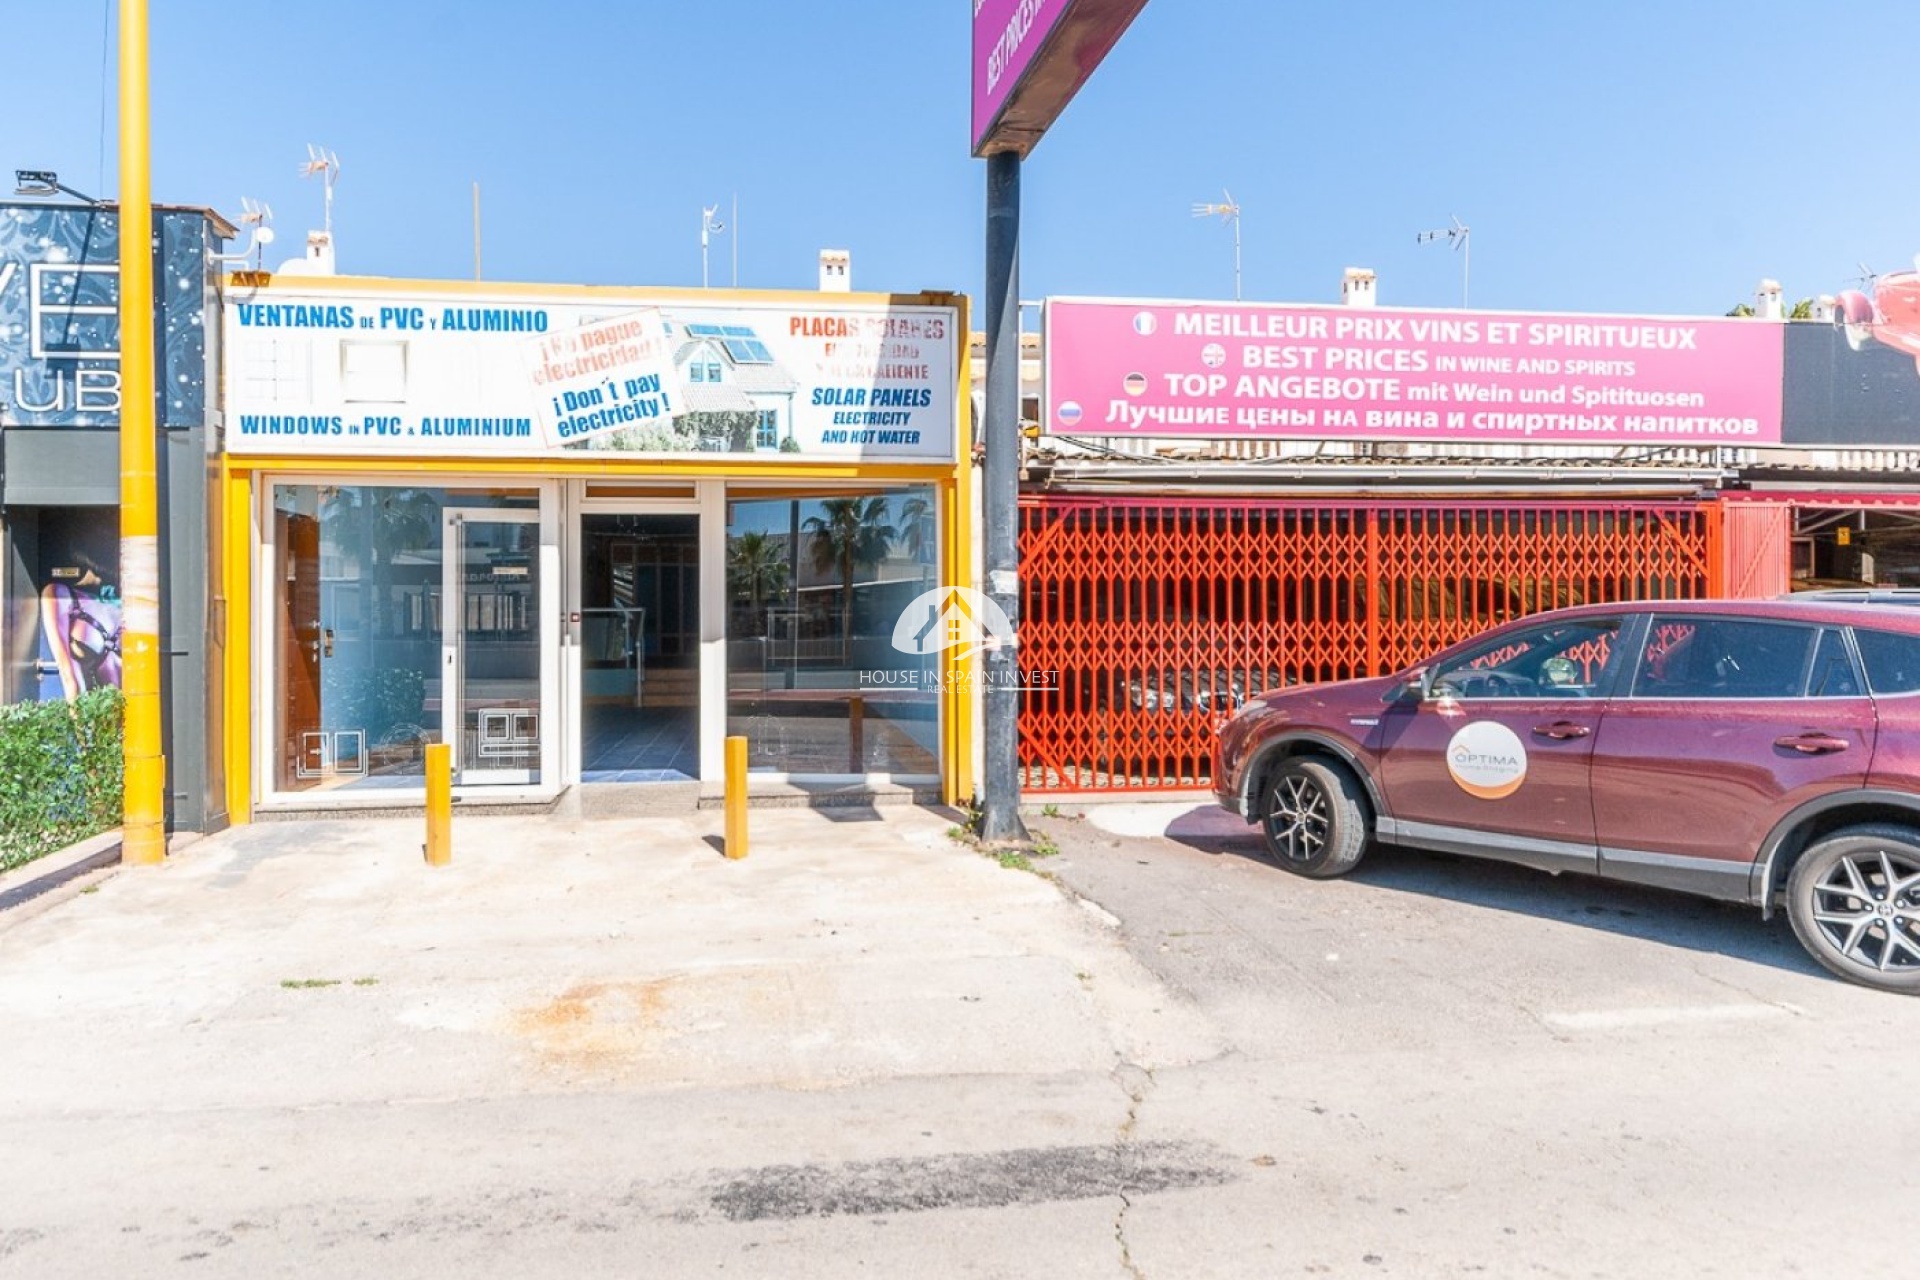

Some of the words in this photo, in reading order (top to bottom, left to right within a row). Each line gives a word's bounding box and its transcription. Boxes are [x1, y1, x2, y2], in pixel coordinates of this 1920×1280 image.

[987, 32, 1006, 96] BEST
[238, 303, 354, 328] VENTANAS
[359, 316, 374, 328] DE
[380, 307, 424, 330] PVC
[429, 318, 437, 331] Y
[442, 309, 548, 332] ALUMINIO
[789, 316, 860, 338] PLACAS
[865, 317, 945, 340] OLARES
[1174, 312, 1328, 340] MEILLEUR
[1335, 316, 1403, 341] PRIX
[1411, 319, 1480, 344] VINS
[1487, 322, 1522, 345] ET
[1528, 322, 1697, 350] SPIRITUEUX
[580, 320, 643, 351] pague
[1243, 344, 1318, 369] BEST
[1325, 347, 1429, 372] PRICES
[1435, 355, 1456, 372] IN
[1459, 356, 1512, 373] WINE
[1516, 358, 1561, 375] AND
[1564, 359, 1636, 376] SPIRITS
[0, 368, 121, 412] UB
[624, 373, 661, 400] pay
[812, 387, 866, 407] SOLAR
[870, 388, 932, 408] PANELS
[1164, 372, 1228, 398] TOP
[1234, 375, 1400, 401] ANGEBOTE
[1407, 382, 1448, 402] mit
[1452, 383, 1513, 403] Wein
[1519, 385, 1566, 404] und
[1571, 386, 1705, 408] Spitituosen
[240, 415, 342, 436] WINDOWS
[349, 424, 360, 435] IN
[364, 416, 402, 437] PVC
[421, 417, 531, 438] ALUMINIUM
[833, 411, 910, 427] ELECTRICITY
[1365, 410, 1440, 428] вина
[1446, 411, 1466, 429] и
[1472, 411, 1618, 435] спиртных
[1624, 414, 1758, 435] напитков
[821, 429, 847, 444] AND
[850, 430, 875, 444] HOT
[877, 430, 920, 445] WATER
[1454, 754, 1518, 766] OPTIMA
